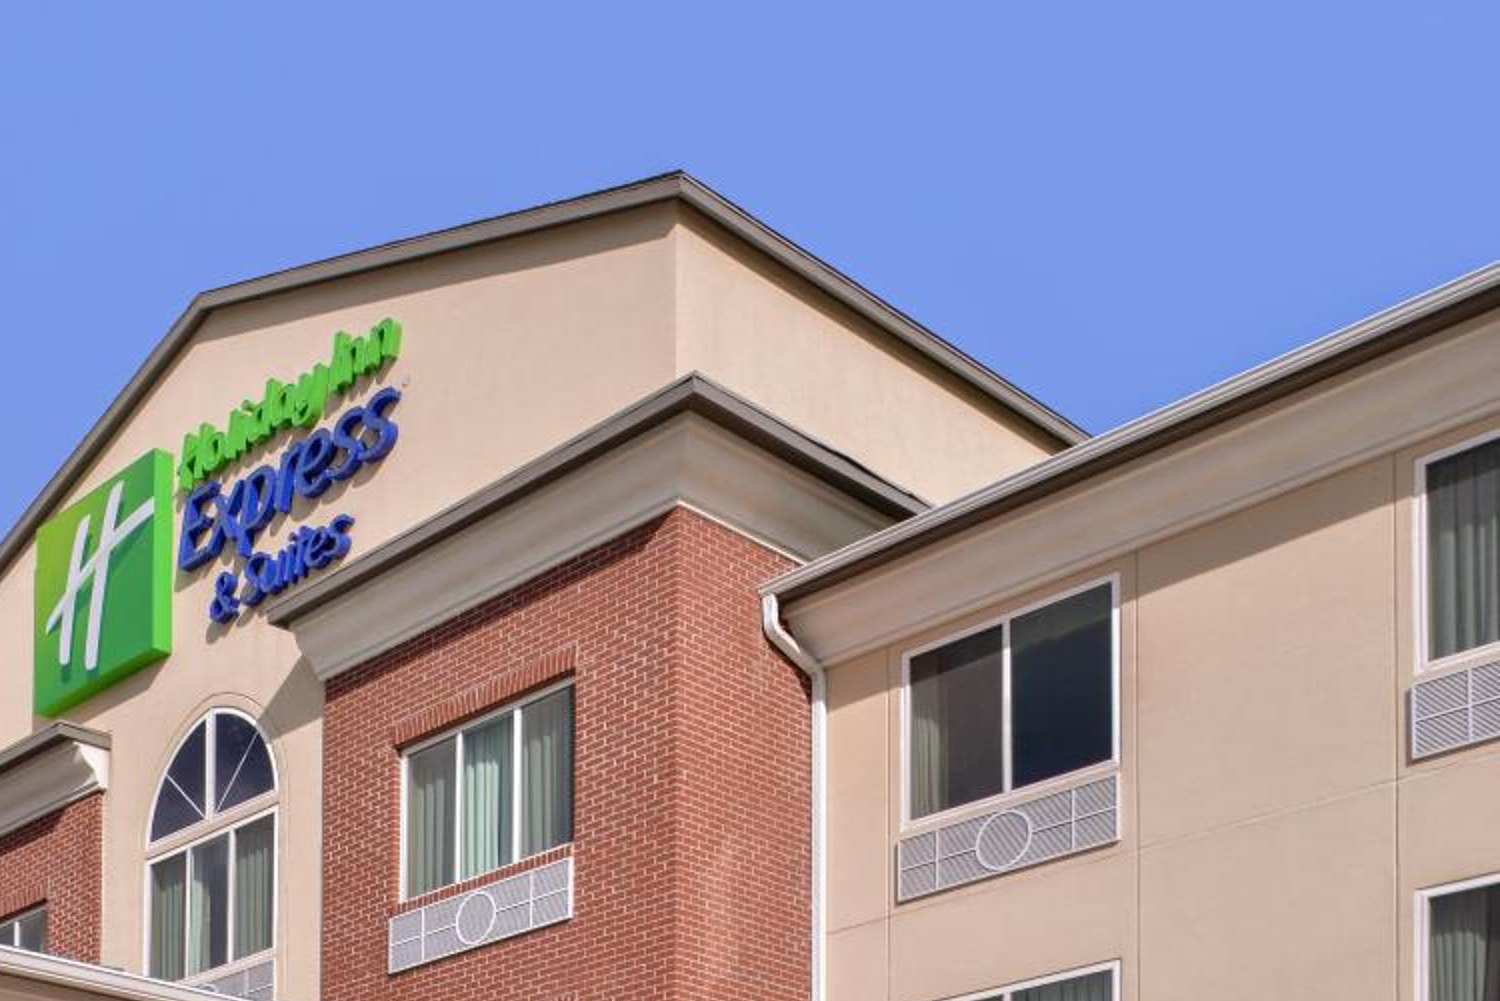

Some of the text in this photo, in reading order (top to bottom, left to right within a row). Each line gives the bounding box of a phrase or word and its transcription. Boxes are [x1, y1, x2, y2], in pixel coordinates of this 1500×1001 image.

[178, 317, 402, 492] Holiday Inn
[178, 386, 402, 572] Express
[209, 513, 356, 625] & Suites
